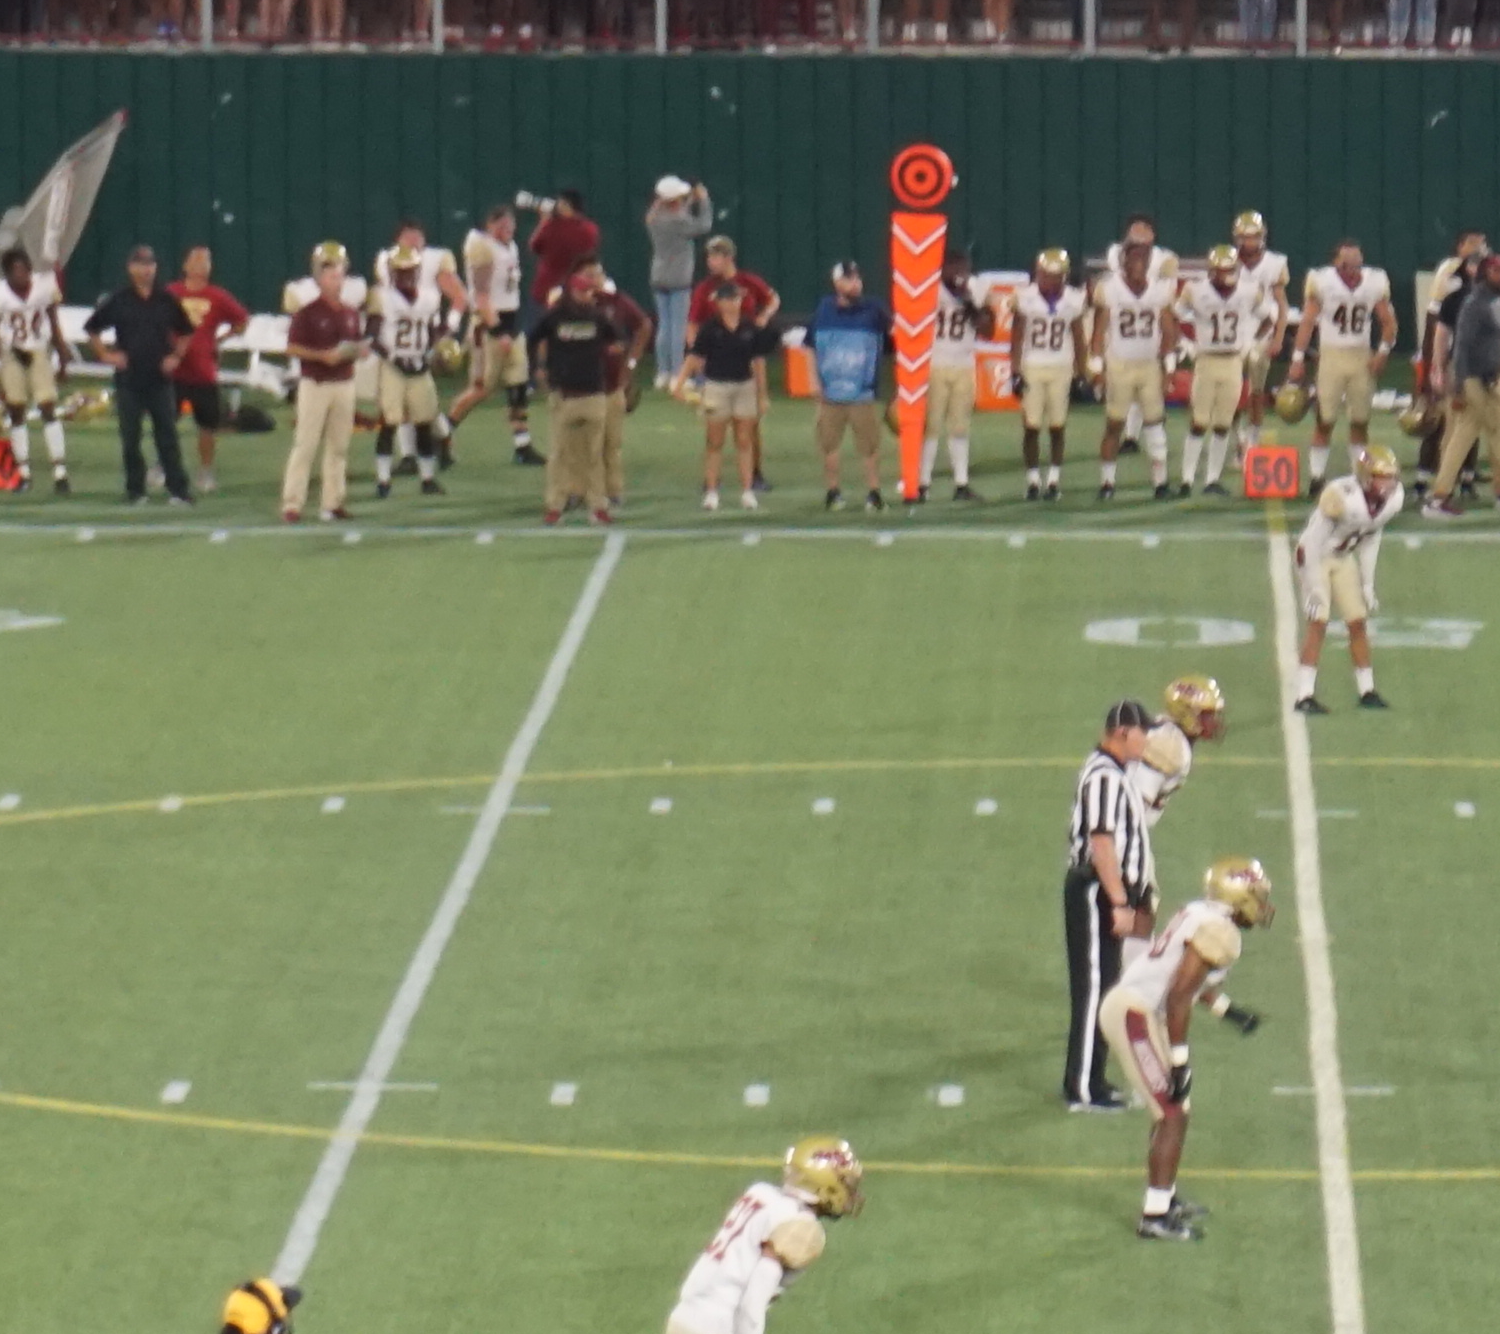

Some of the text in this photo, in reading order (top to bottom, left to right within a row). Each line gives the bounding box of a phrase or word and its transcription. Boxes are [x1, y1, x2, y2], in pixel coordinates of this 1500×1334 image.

[396, 318, 423, 350] 21
[936, 308, 964, 341] 18
[1031, 317, 1066, 351] 28
[1120, 308, 1156, 339] 23
[1210, 311, 1238, 345] 13
[1333, 304, 1367, 335] 46
[1252, 455, 1294, 491] 50
